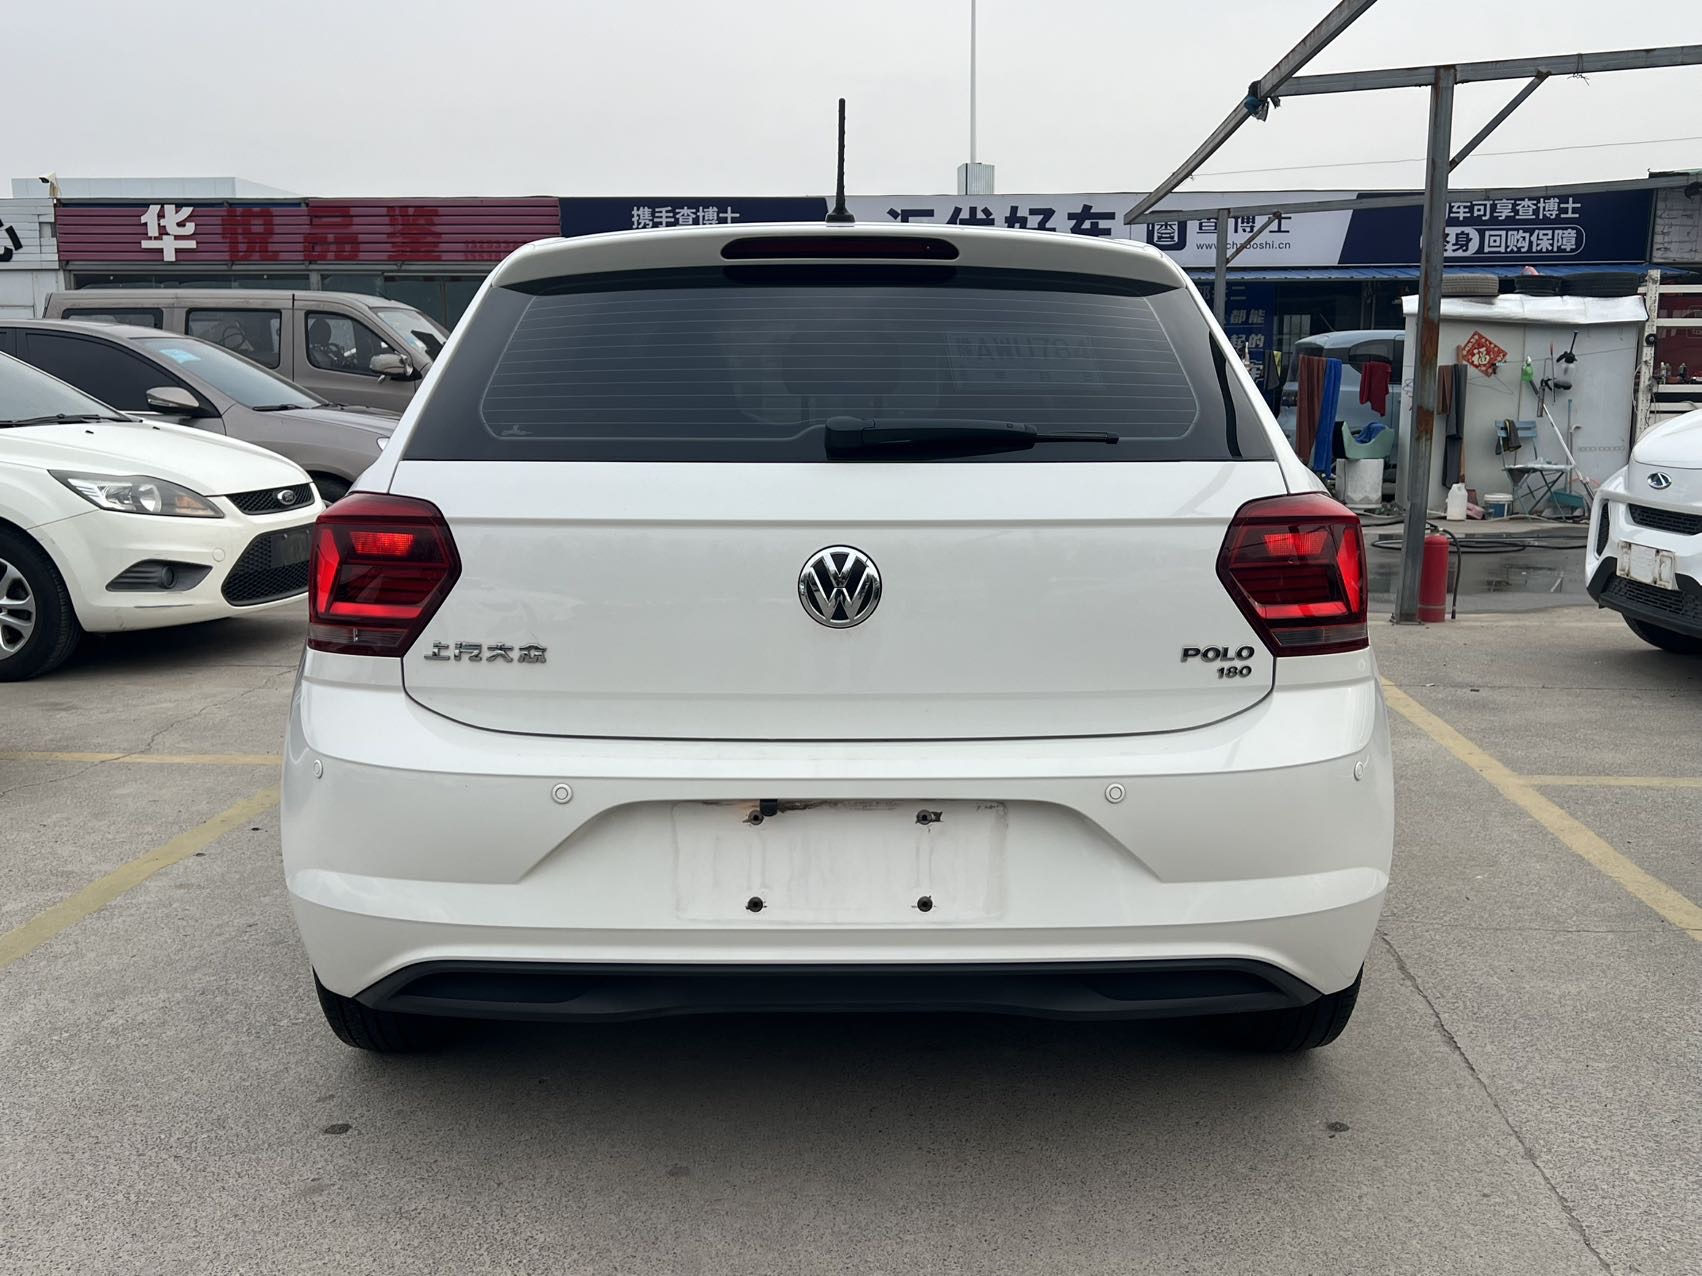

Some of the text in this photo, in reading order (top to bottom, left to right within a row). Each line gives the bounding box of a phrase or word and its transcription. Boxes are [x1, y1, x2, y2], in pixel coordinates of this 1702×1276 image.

[632, 206, 740, 229] 携手查博士
[1446, 197, 1581, 220] 车可享查博士
[1196, 240, 1291, 250] wwchoshi.cn
[1484, 229, 1577, 253] 回购保障
[424, 641, 547, 663] 上汽大众
[1180, 645, 1255, 663] POLO
[1217, 665, 1252, 680] 180
